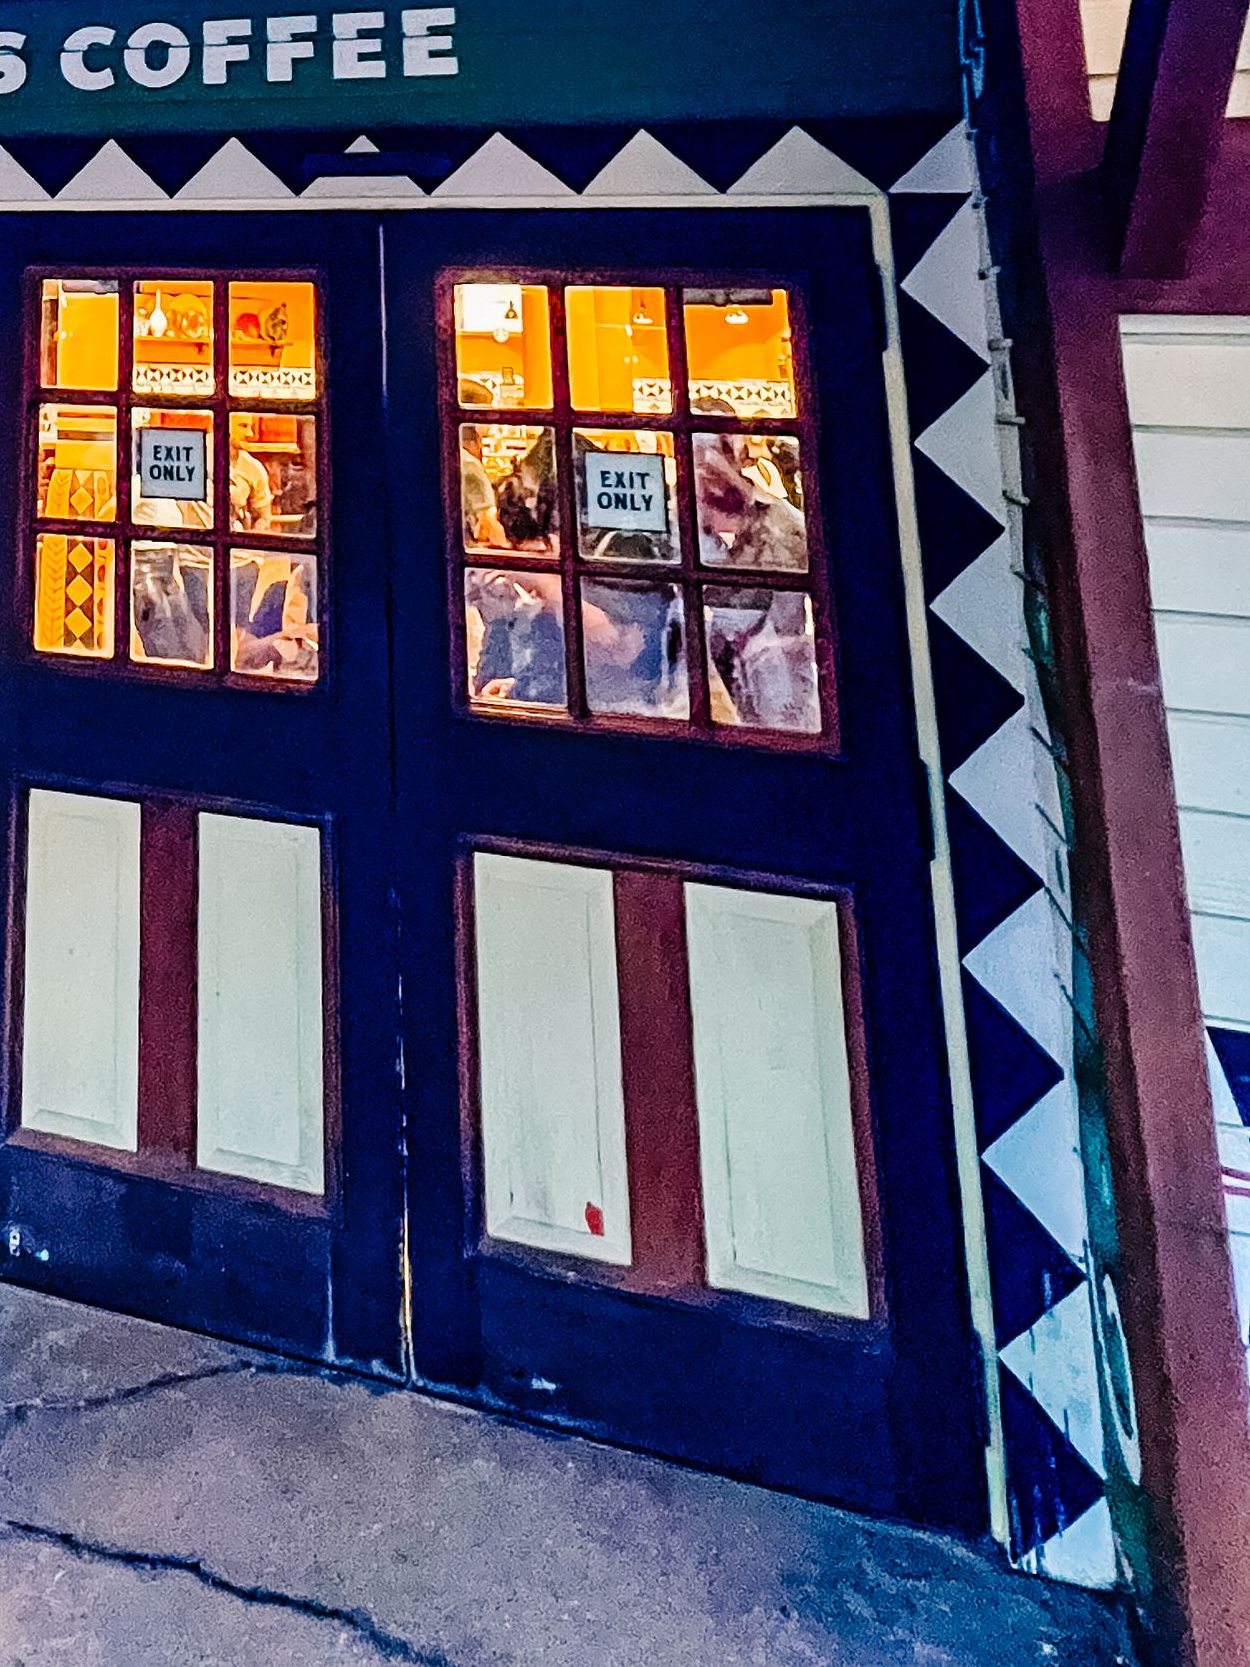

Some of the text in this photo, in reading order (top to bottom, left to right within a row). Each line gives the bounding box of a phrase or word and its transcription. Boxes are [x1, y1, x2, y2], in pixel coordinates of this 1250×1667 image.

[60, 8, 459, 91] COFFEE
[153, 444, 194, 462] EXIT
[149, 464, 196, 482] ONLY
[600, 470, 650, 490] EXIT
[597, 491, 653, 512] ONLY
